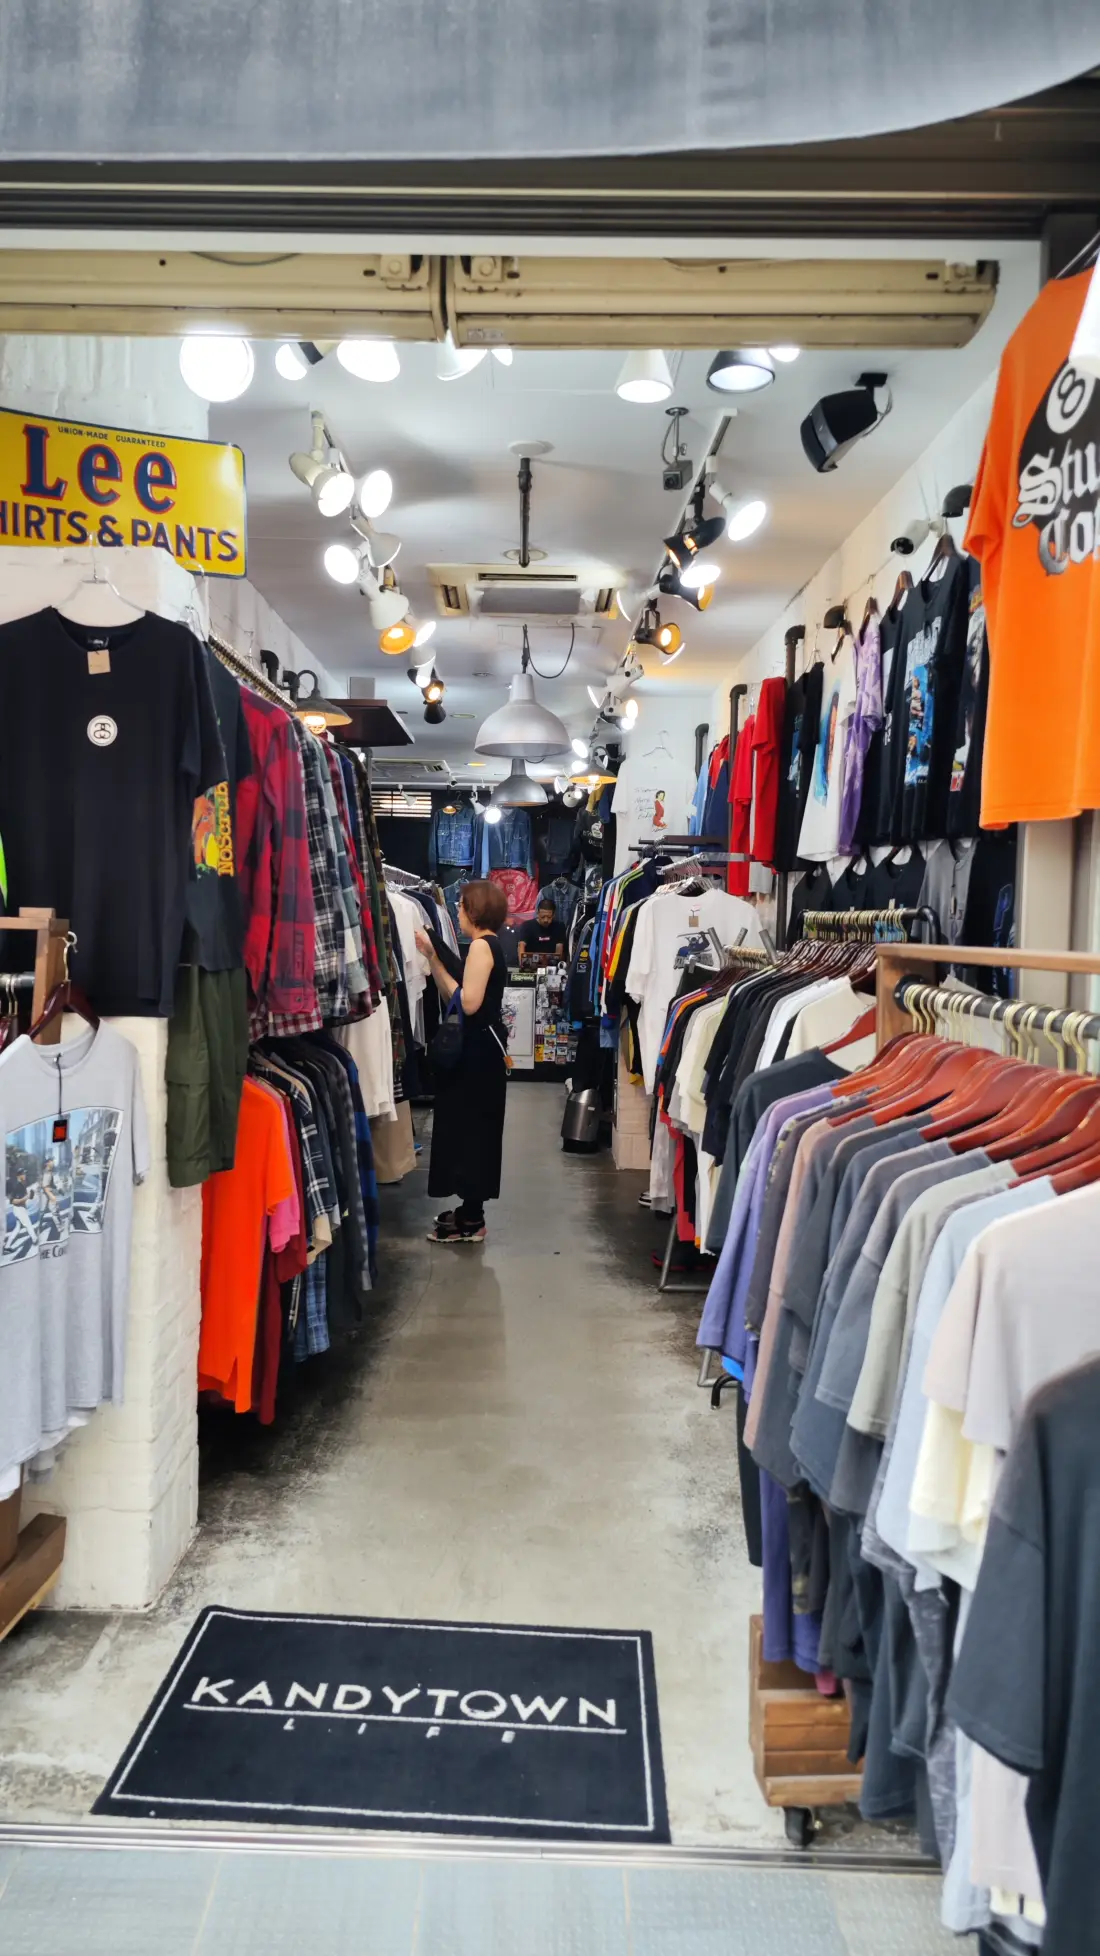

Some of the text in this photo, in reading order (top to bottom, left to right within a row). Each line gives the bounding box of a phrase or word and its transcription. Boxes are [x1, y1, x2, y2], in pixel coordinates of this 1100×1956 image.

[1057, 367, 1086, 419] 8
[115, 434, 166, 448] GUARANTEED
[20, 423, 178, 515] Lee
[97, 514, 124, 547] &
[131, 518, 239, 562] PANTS
[190, 1676, 617, 1726] KANDYTOWN
